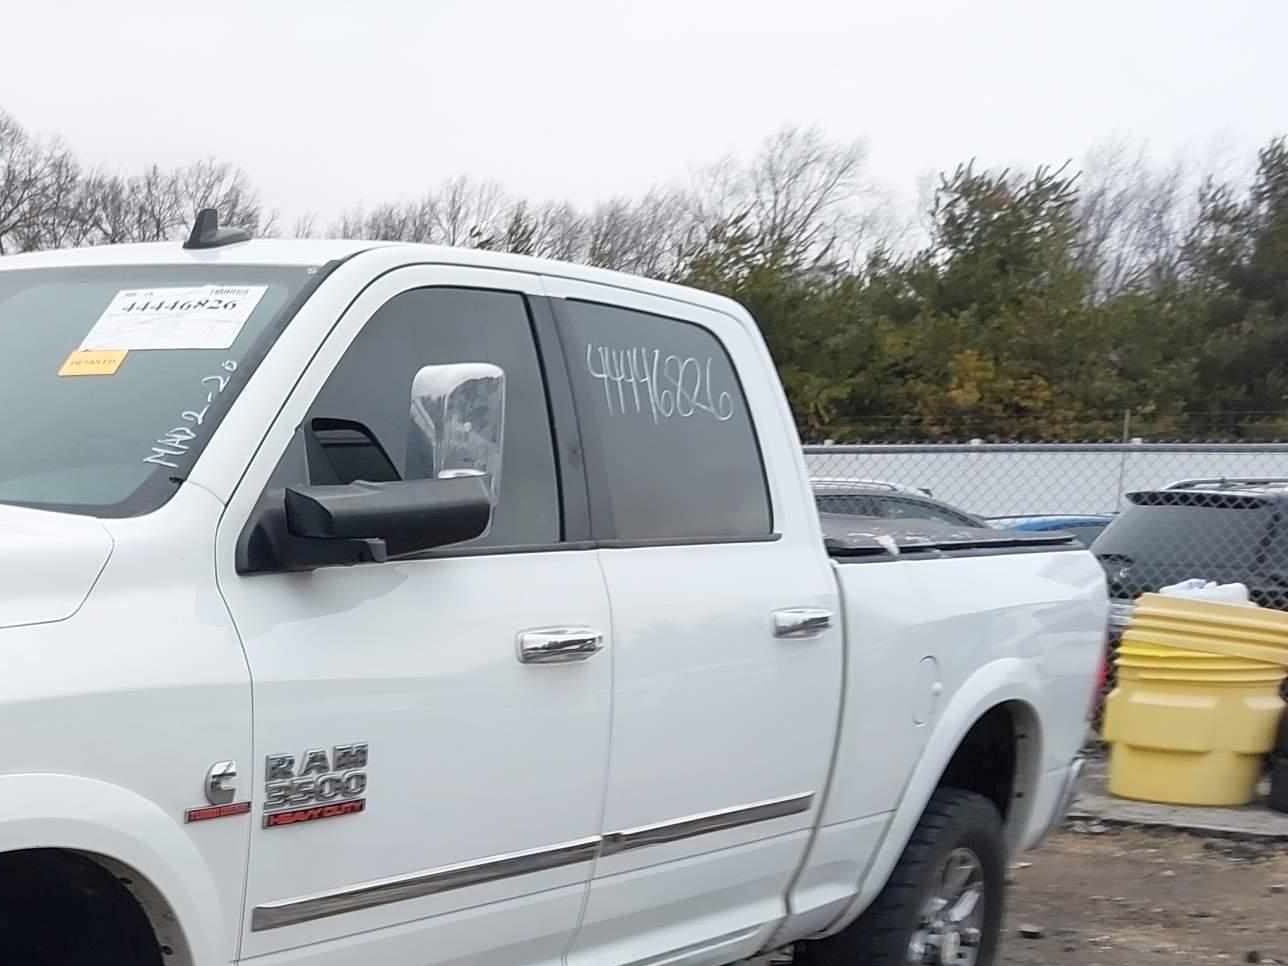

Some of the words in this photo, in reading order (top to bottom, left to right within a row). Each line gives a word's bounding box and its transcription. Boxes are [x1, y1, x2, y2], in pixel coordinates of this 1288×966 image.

[122, 299, 237, 312] 44446826
[586, 344, 734, 425] 44446826
[265, 742, 368, 781] RAM
[263, 770, 368, 811] 3500
